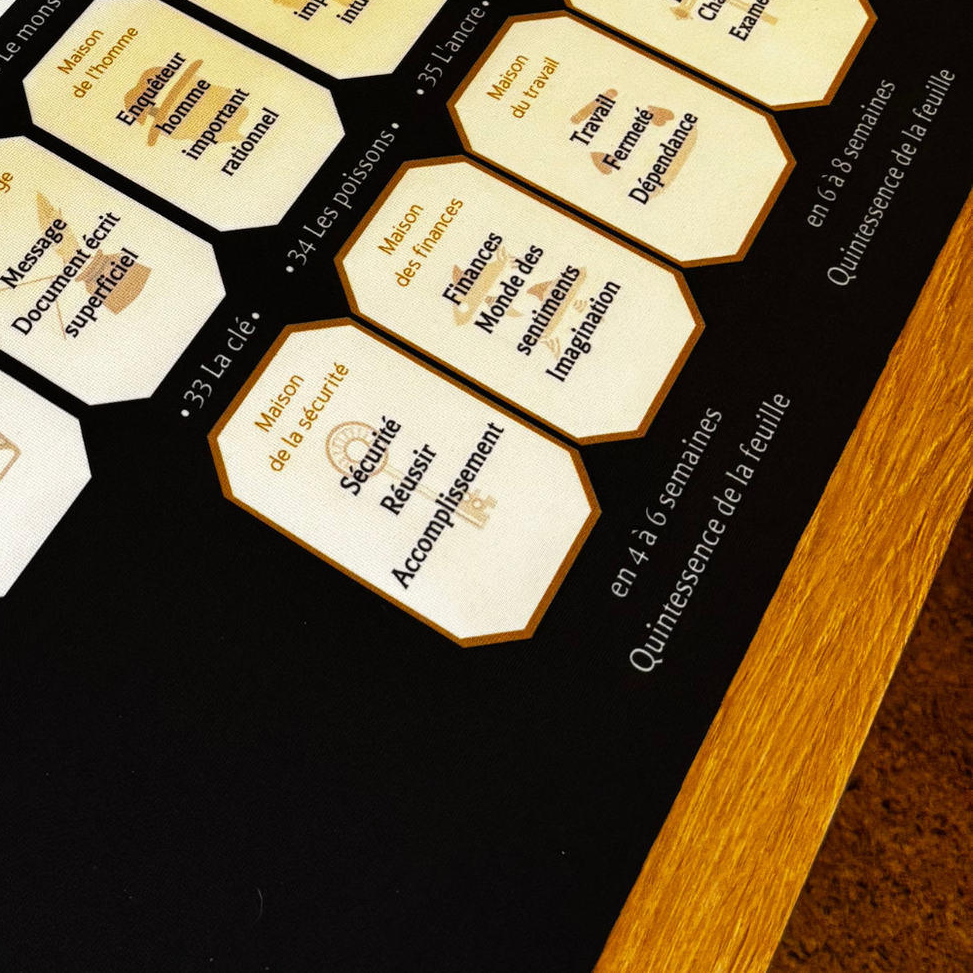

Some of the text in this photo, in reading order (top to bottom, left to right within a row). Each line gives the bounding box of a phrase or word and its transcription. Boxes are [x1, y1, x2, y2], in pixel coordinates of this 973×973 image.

[114, 51, 187, 127] Enquêteur
[153, 78, 212, 136] homme
[180, 87, 251, 162] important
[220, 106, 280, 177] rationnel
[806, 78, 897, 229] en 6 à 8 semaines
[826, 68, 956, 287] Quintessence de la feuille
[441, 231, 504, 307] Finances
[473, 243, 545, 335] Monde des
[516, 264, 581, 357] sentiments
[182, 315, 257, 410] 33 La clé
[544, 280, 622, 384] Imagination
[252, 373, 306, 434] Maison
[267, 361, 350, 473] de la sécurité
[339, 414, 403, 497] Sécurité
[378, 443, 438, 517] Réussir
[390, 421, 506, 591] Accomplissement
[610, 406, 723, 599] en 4 à 6 semaines
[628, 393, 792, 673] Quintessence de la feuille
